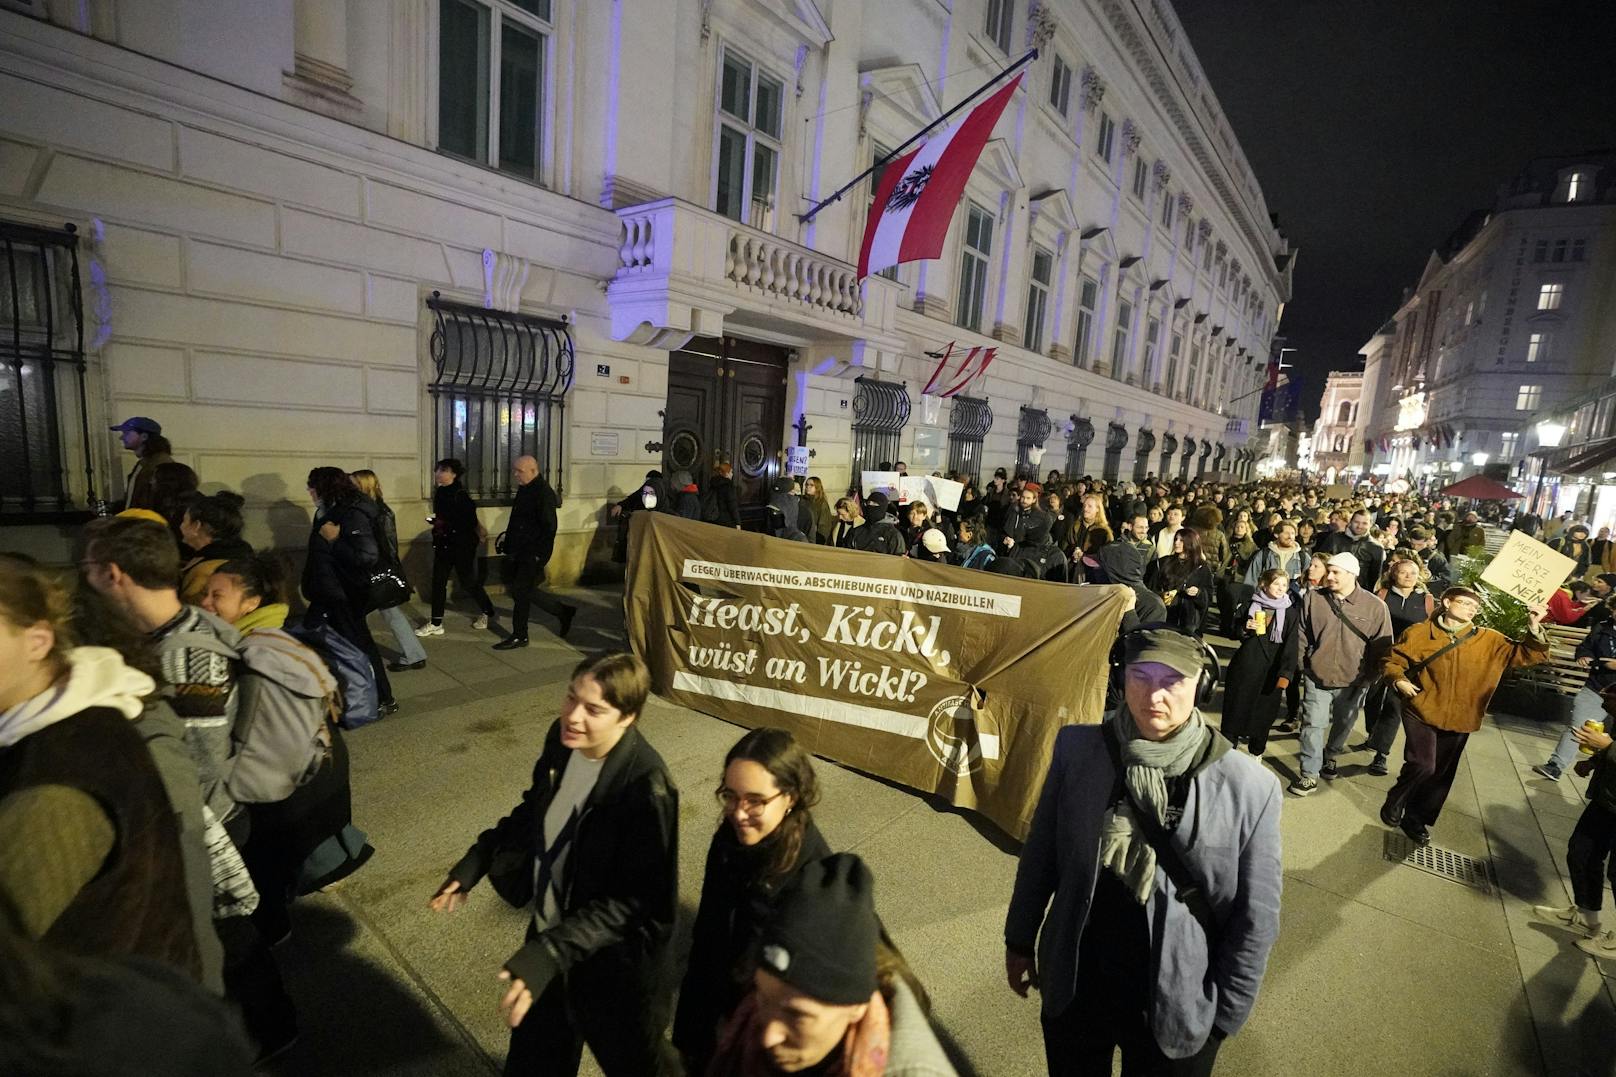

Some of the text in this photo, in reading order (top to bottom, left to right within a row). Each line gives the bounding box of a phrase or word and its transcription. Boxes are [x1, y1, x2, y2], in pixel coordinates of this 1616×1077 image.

[1512, 541, 1544, 559] MEIN
[1512, 569, 1543, 588] SAGT
[1514, 556, 1550, 579] HERZ
[691, 564, 721, 577] GEGEN
[804, 576, 898, 596] ABSCHIEBUNGEN
[900, 586, 924, 600] UND
[926, 590, 995, 609] NAZIBULLEN
[1510, 583, 1546, 605] NEIN
[686, 595, 951, 667] Heast, Kickl,
[689, 642, 928, 703] wüst an Wickl?
